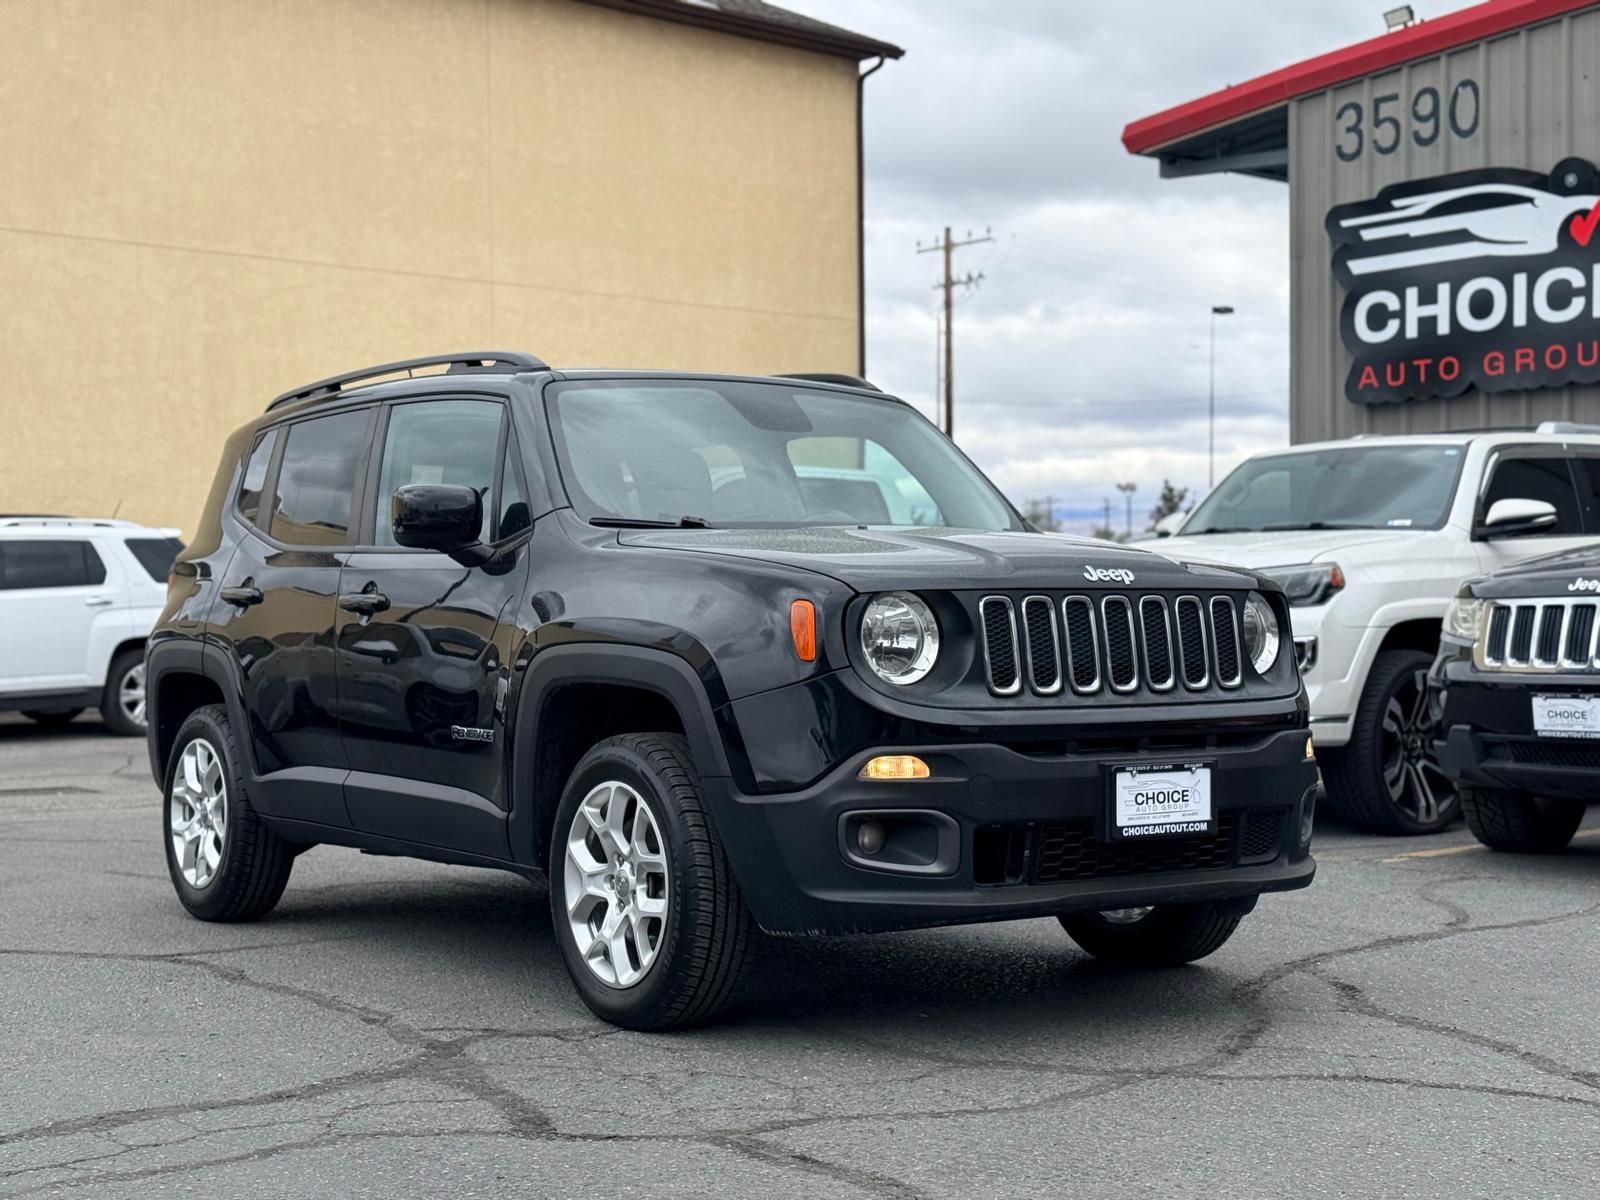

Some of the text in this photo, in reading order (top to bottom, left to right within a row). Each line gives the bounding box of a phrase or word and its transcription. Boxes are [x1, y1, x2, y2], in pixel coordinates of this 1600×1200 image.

[1335, 79, 1480, 162] 3590
[1358, 340, 1599, 390] AUTO GROU
[1083, 565, 1135, 585] Jeep
[1547, 710, 1588, 721] CHOICE
[1135, 789, 1189, 806] CHOICE
[1135, 803, 1190, 813] AUTO GROUP
[1122, 822, 1208, 836] CHOICEAUTOUT.COM
